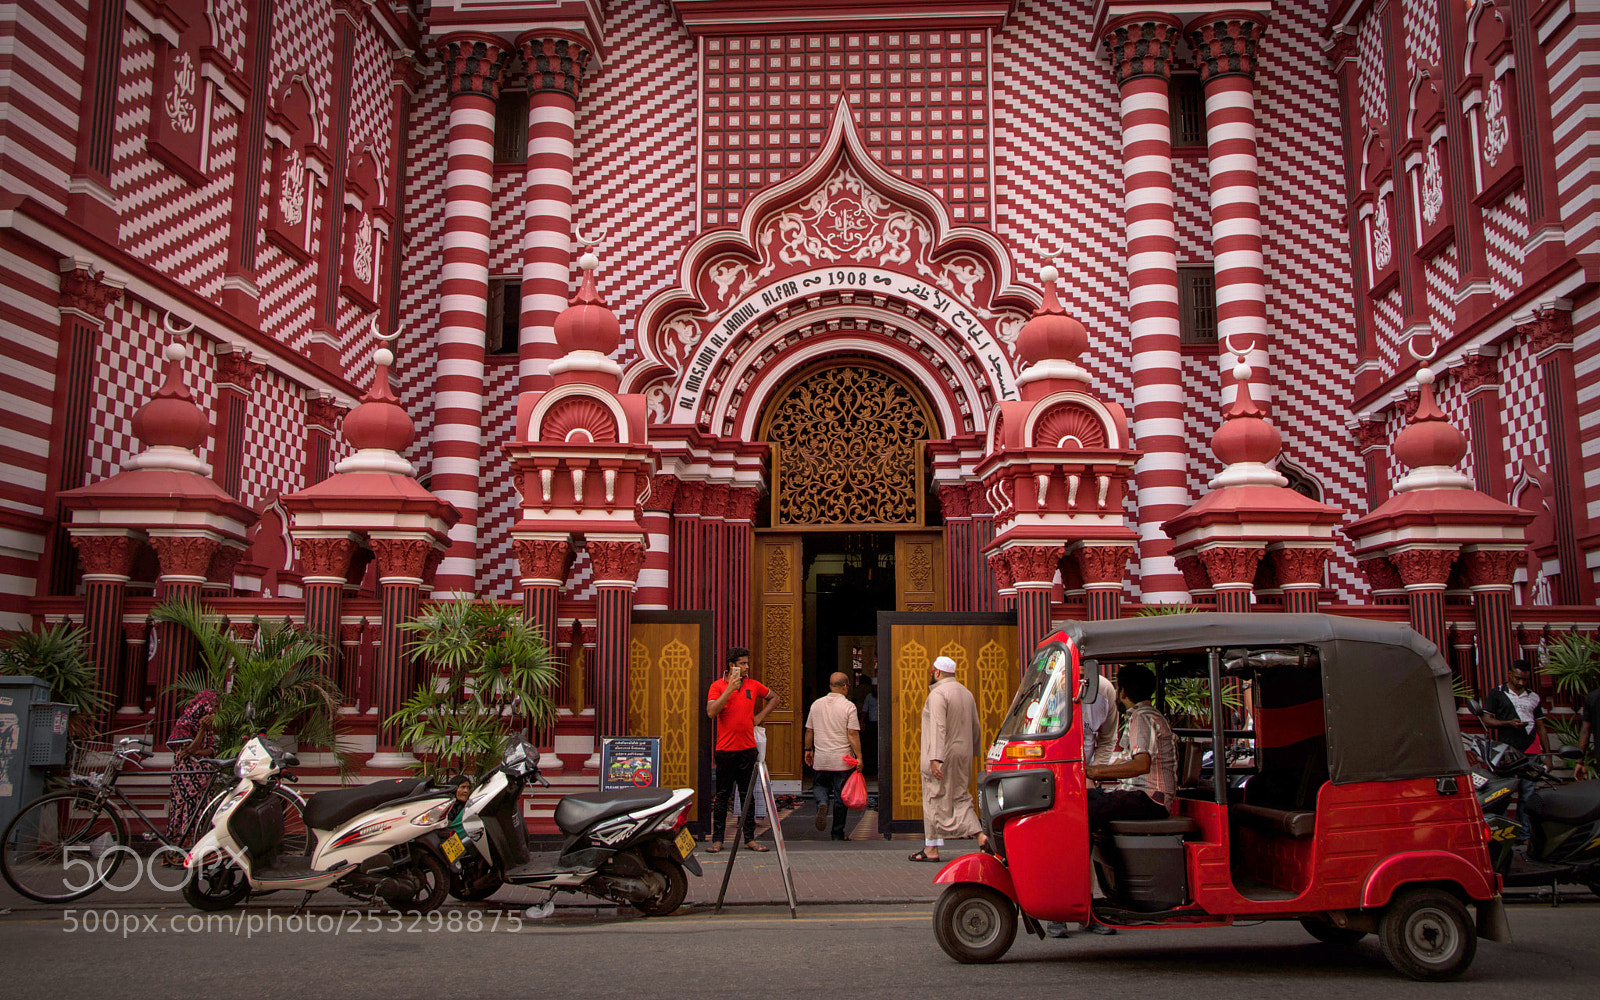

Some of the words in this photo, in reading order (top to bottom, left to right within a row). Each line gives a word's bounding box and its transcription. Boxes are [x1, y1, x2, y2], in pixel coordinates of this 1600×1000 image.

[828, 271, 867, 286] 1908
[679, 396, 696, 410] AL
[710, 333, 728, 349] AL
[722, 302, 760, 336] JAMIUL
[761, 281, 799, 307] ALFAR
